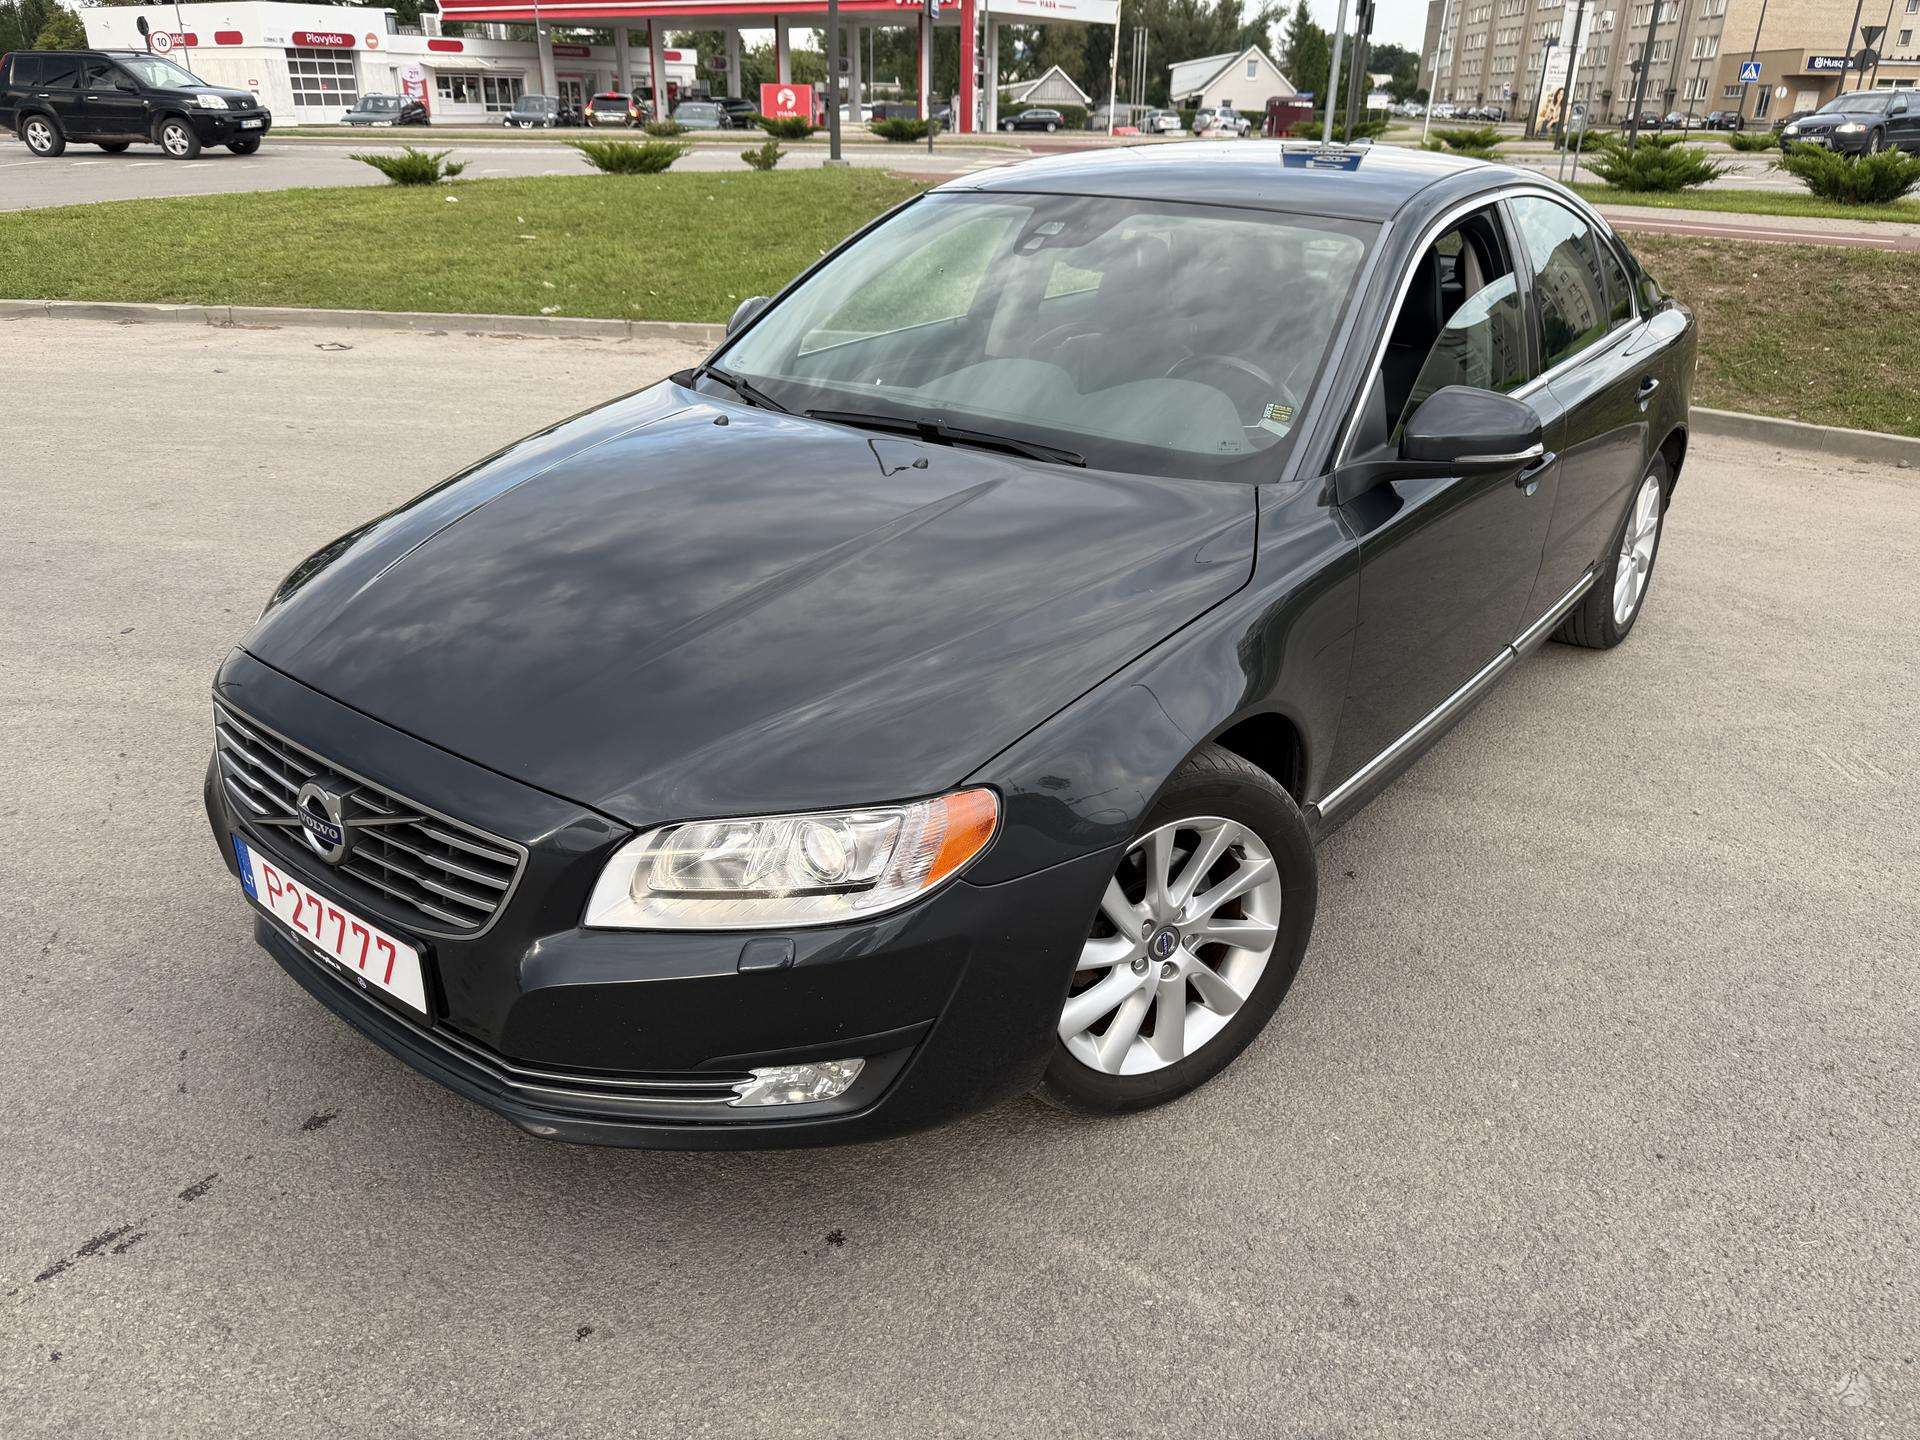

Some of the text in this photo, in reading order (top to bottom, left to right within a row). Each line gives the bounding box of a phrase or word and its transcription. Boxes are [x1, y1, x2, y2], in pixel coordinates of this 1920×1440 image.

[156, 37, 167, 47] 10
[306, 33, 343, 46] Plovykla
[299, 809, 339, 840] VOLVO
[243, 871, 255, 888] LT
[262, 862, 397, 986] P27777
